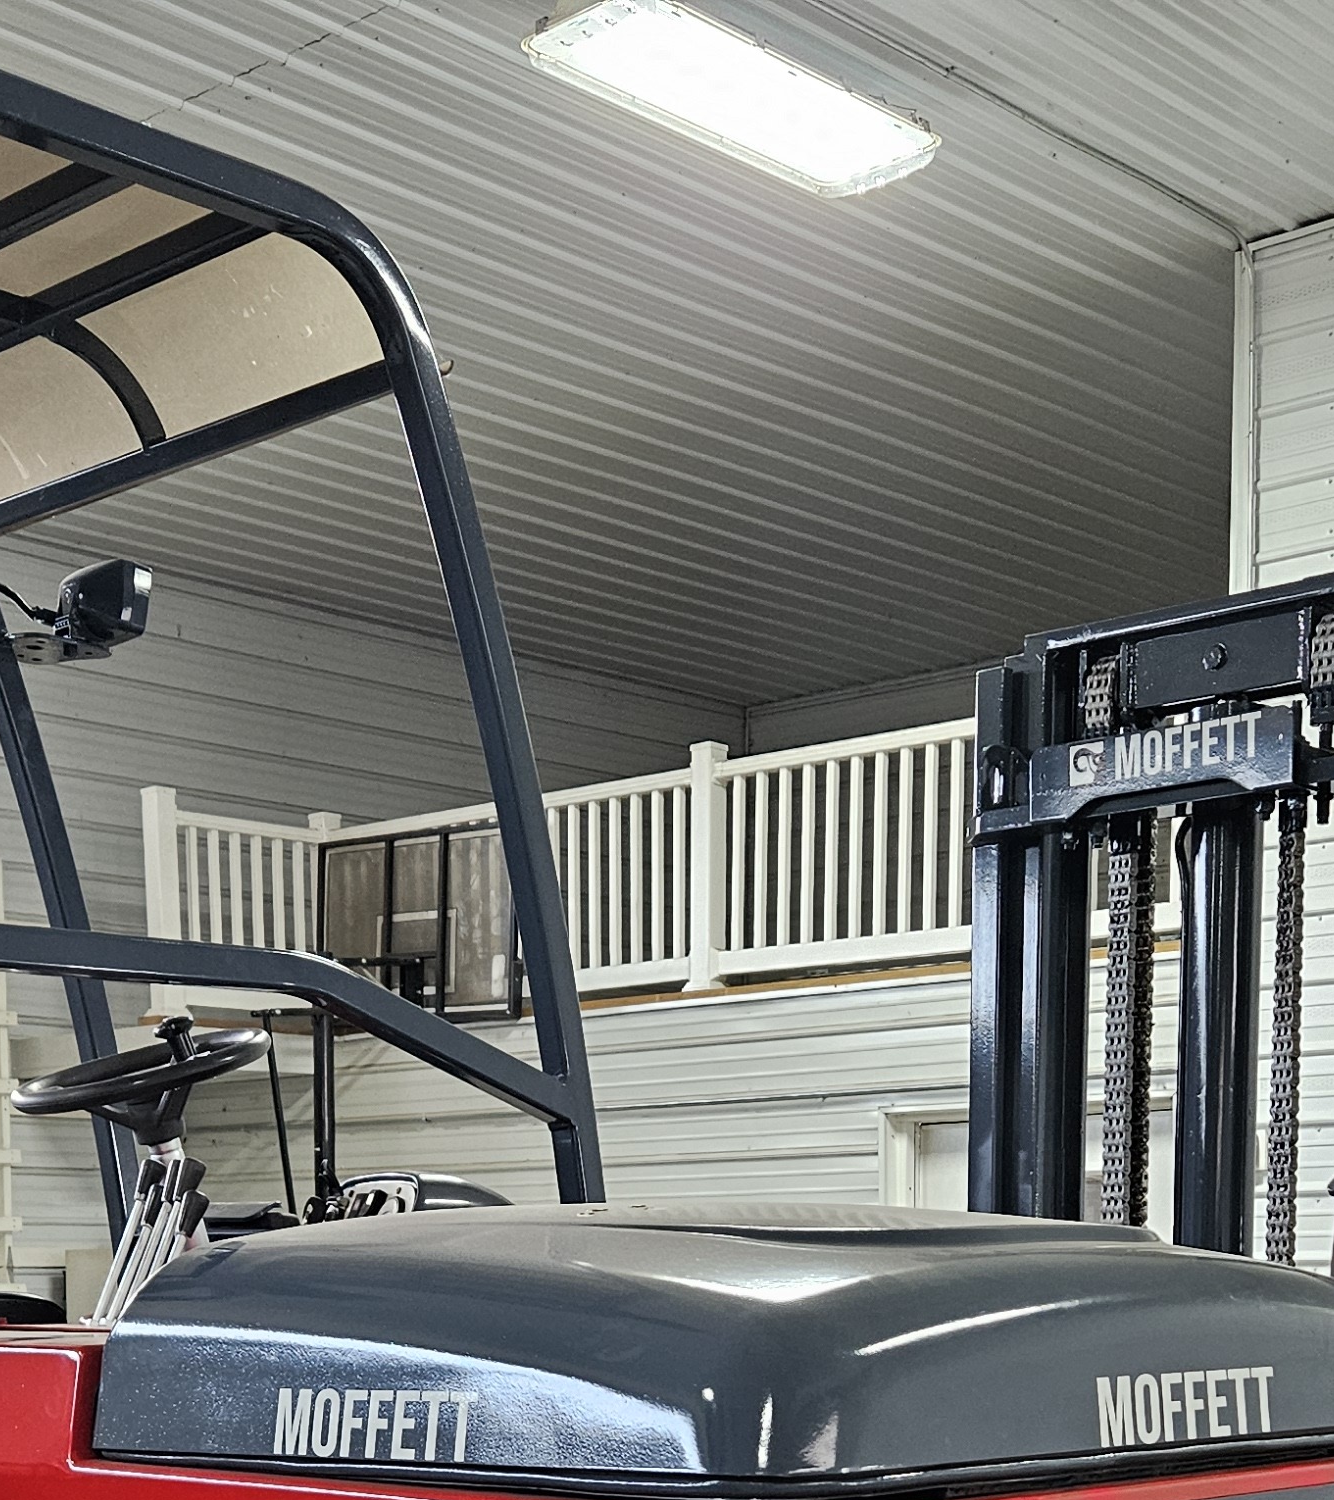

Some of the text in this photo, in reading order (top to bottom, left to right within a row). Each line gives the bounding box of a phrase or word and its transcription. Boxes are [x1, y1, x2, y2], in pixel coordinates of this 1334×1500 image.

[1114, 711, 1262, 780] MOFFETT
[273, 1387, 478, 1462] MOFFETT
[1096, 1366, 1274, 1447] MOFFETT
